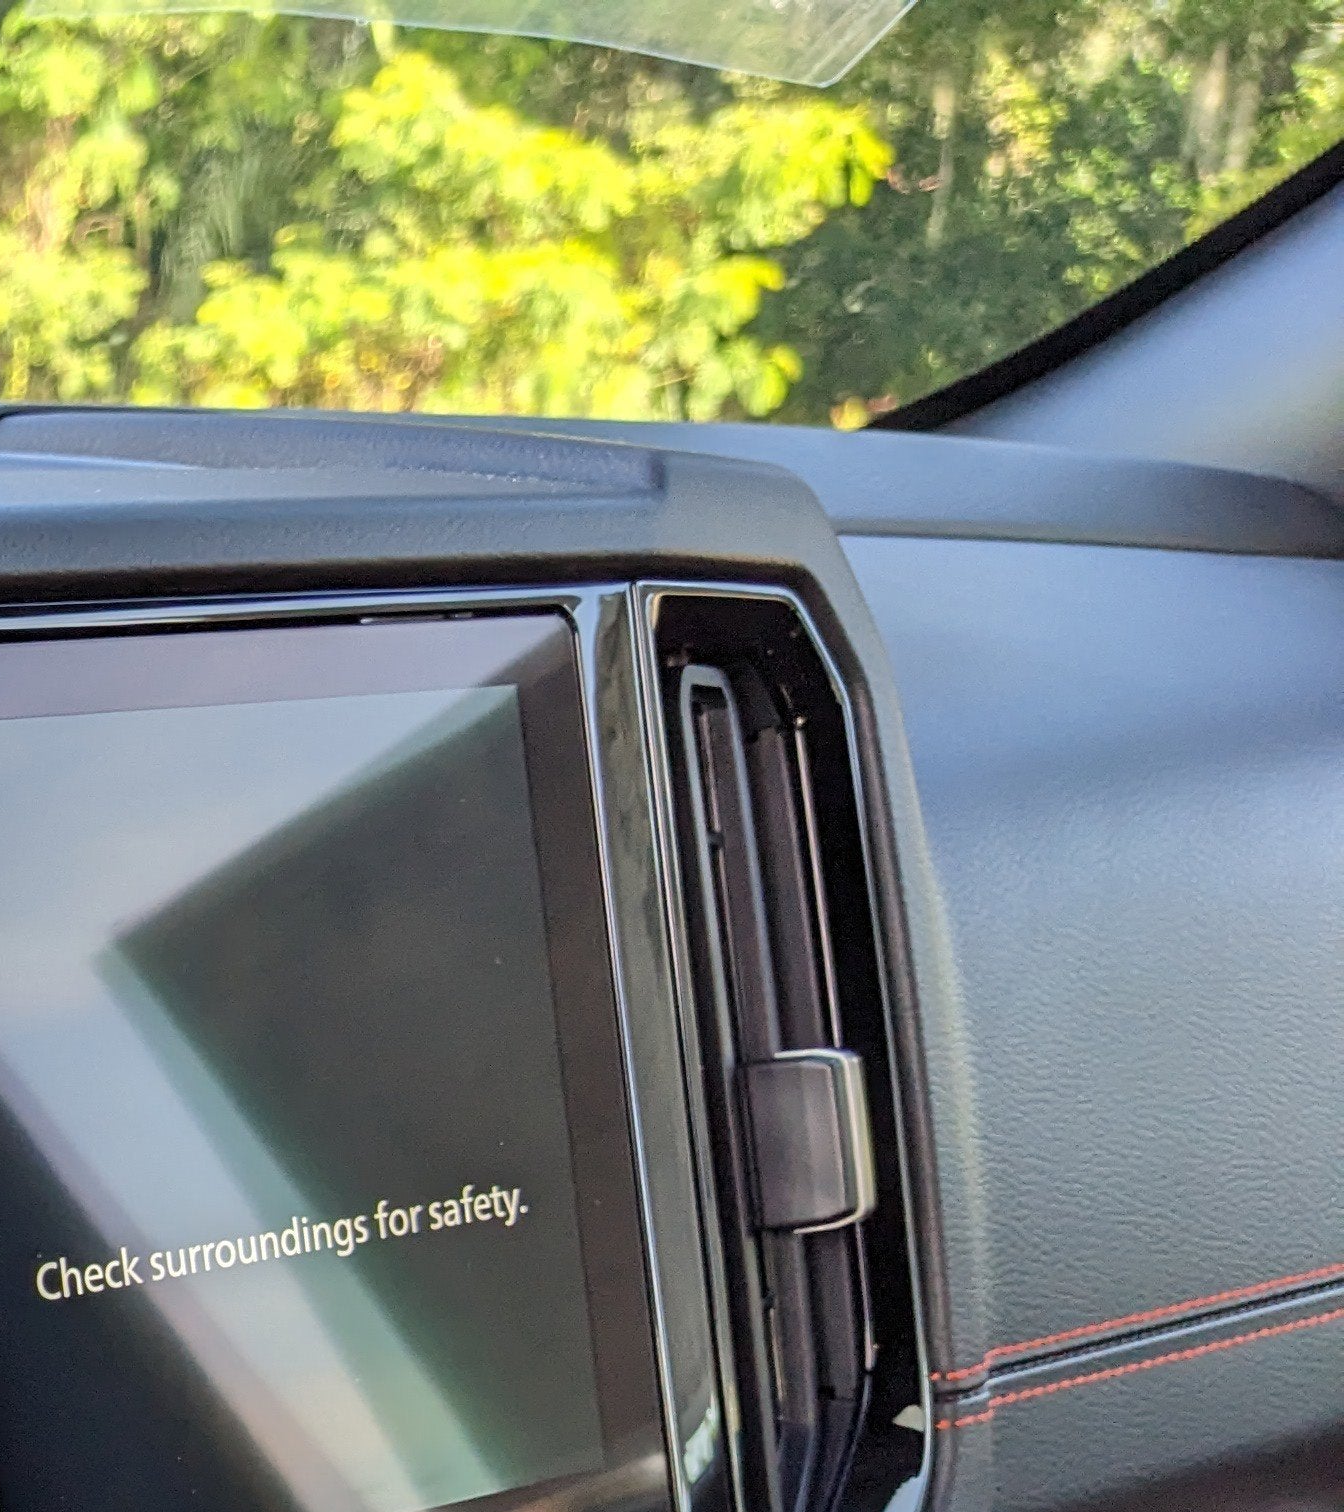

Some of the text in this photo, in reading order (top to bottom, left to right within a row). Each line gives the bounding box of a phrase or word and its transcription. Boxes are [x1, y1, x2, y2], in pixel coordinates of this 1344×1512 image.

[36, 1184, 529, 1301] Check surroundings for safety.
